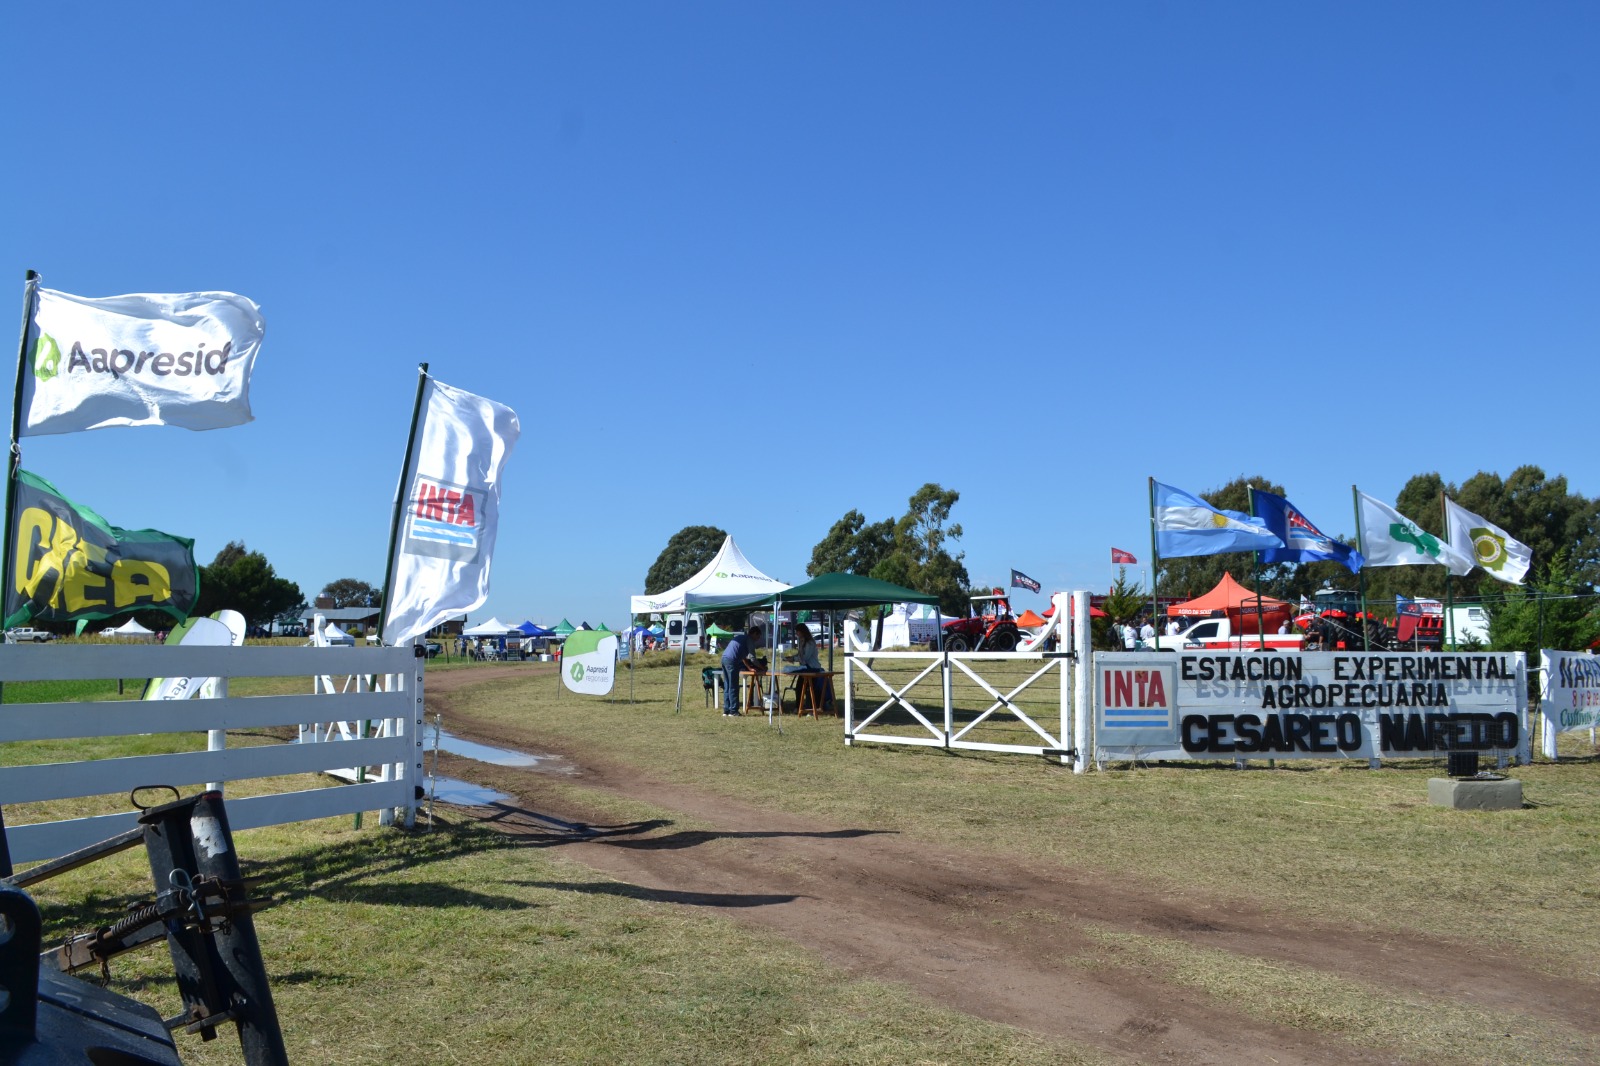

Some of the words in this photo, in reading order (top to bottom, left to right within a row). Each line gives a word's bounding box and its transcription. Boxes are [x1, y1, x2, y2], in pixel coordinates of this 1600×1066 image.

[68, 341, 231, 379] Aapresid
[416, 483, 475, 527] INTA
[731, 573, 773, 582] Aapresid
[586, 665, 608, 674] Aapresid
[1181, 656, 1302, 680] ESTACION
[1334, 656, 1515, 680] EXPERIMENTAL
[1104, 670, 1167, 707] INTA
[1261, 683, 1449, 708] AGROPECUARIA
[1572, 690, 1577, 707] 8
[1586, 690, 1591, 706] 9
[1182, 713, 1362, 752] CESAREO
[1379, 711, 1519, 751] NAREDO
